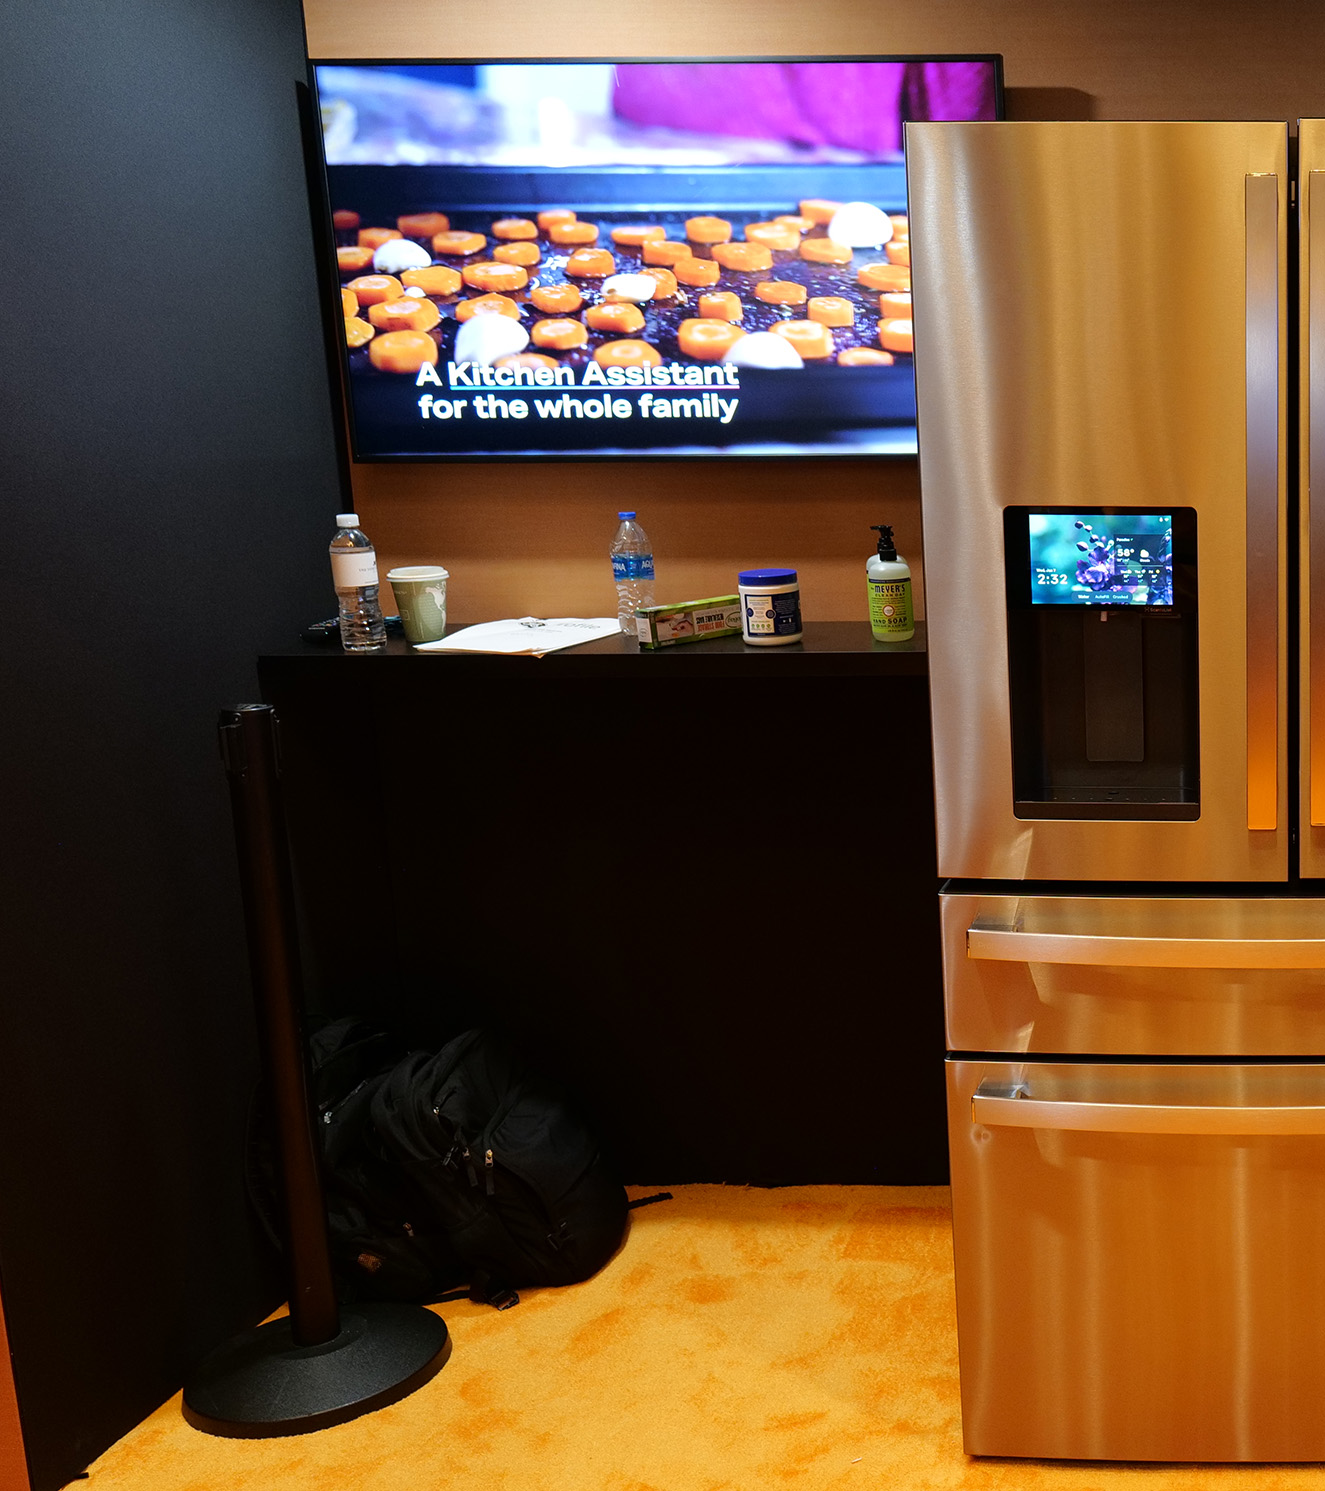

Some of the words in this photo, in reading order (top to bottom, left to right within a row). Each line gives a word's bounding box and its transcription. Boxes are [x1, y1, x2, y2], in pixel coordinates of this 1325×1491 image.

[416, 362, 442, 386] A
[449, 361, 575, 386] Kitchen
[582, 360, 740, 386] Assistant
[418, 394, 468, 419] for
[473, 394, 529, 419] the
[534, 394, 633, 418] whole
[638, 393, 739, 424] family
[1038, 574, 1068, 584] 2:32
[887, 616, 907, 624] SOAP
